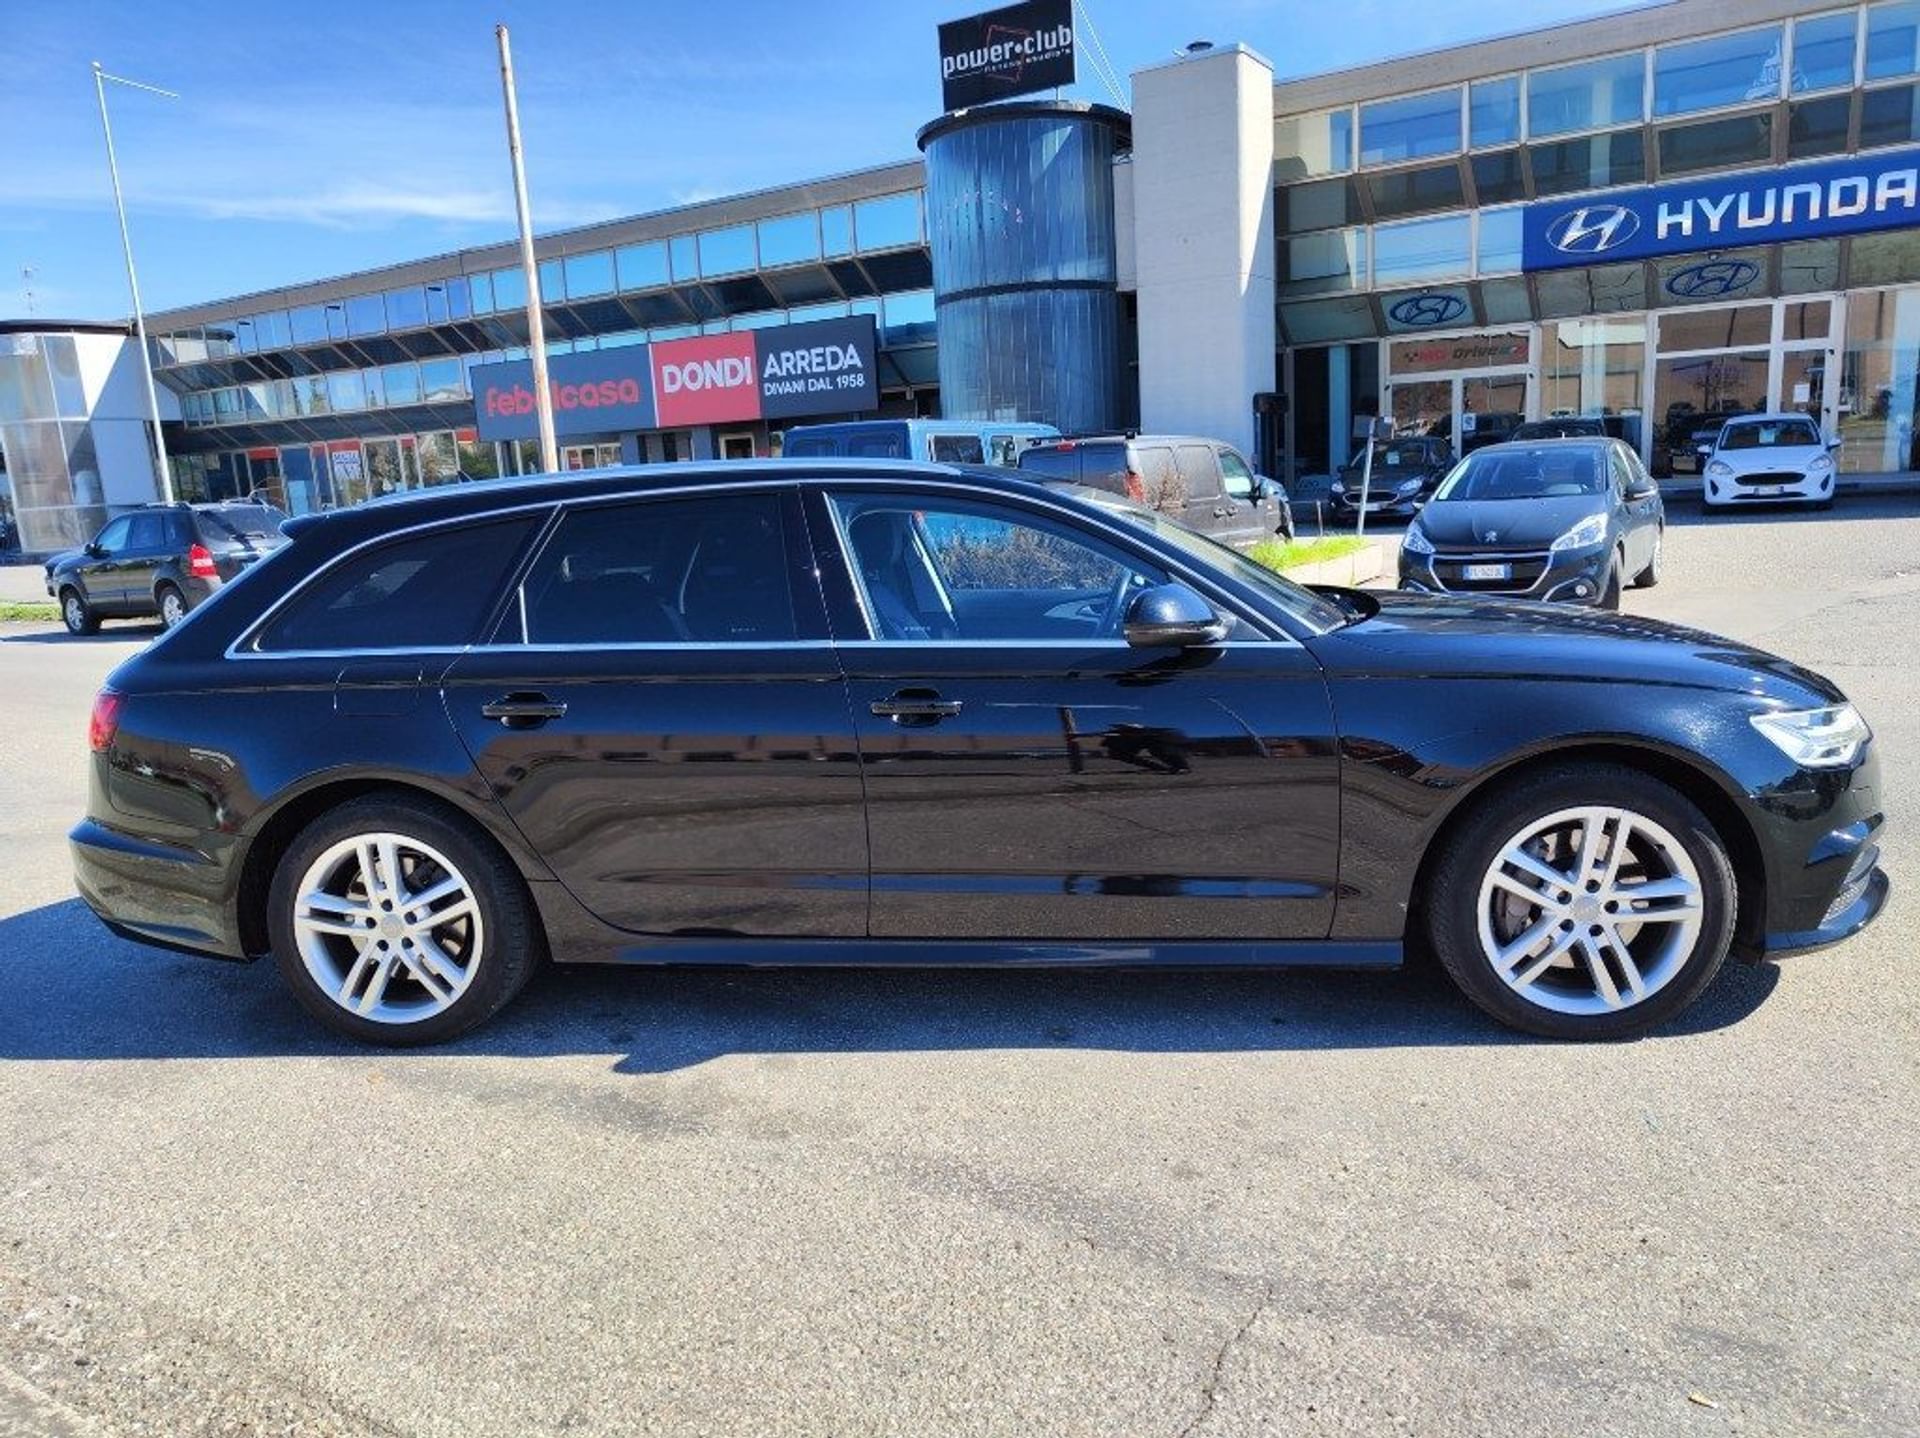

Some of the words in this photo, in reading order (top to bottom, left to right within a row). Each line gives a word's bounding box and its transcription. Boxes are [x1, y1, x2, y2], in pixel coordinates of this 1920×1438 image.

[661, 356, 753, 394] DONDI
[763, 343, 863, 379] ARREDA
[485, 378, 640, 419] feblcasa
[764, 381, 806, 397] DIVANI
[807, 376, 834, 392] DAL
[835, 373, 866, 390] 1958
